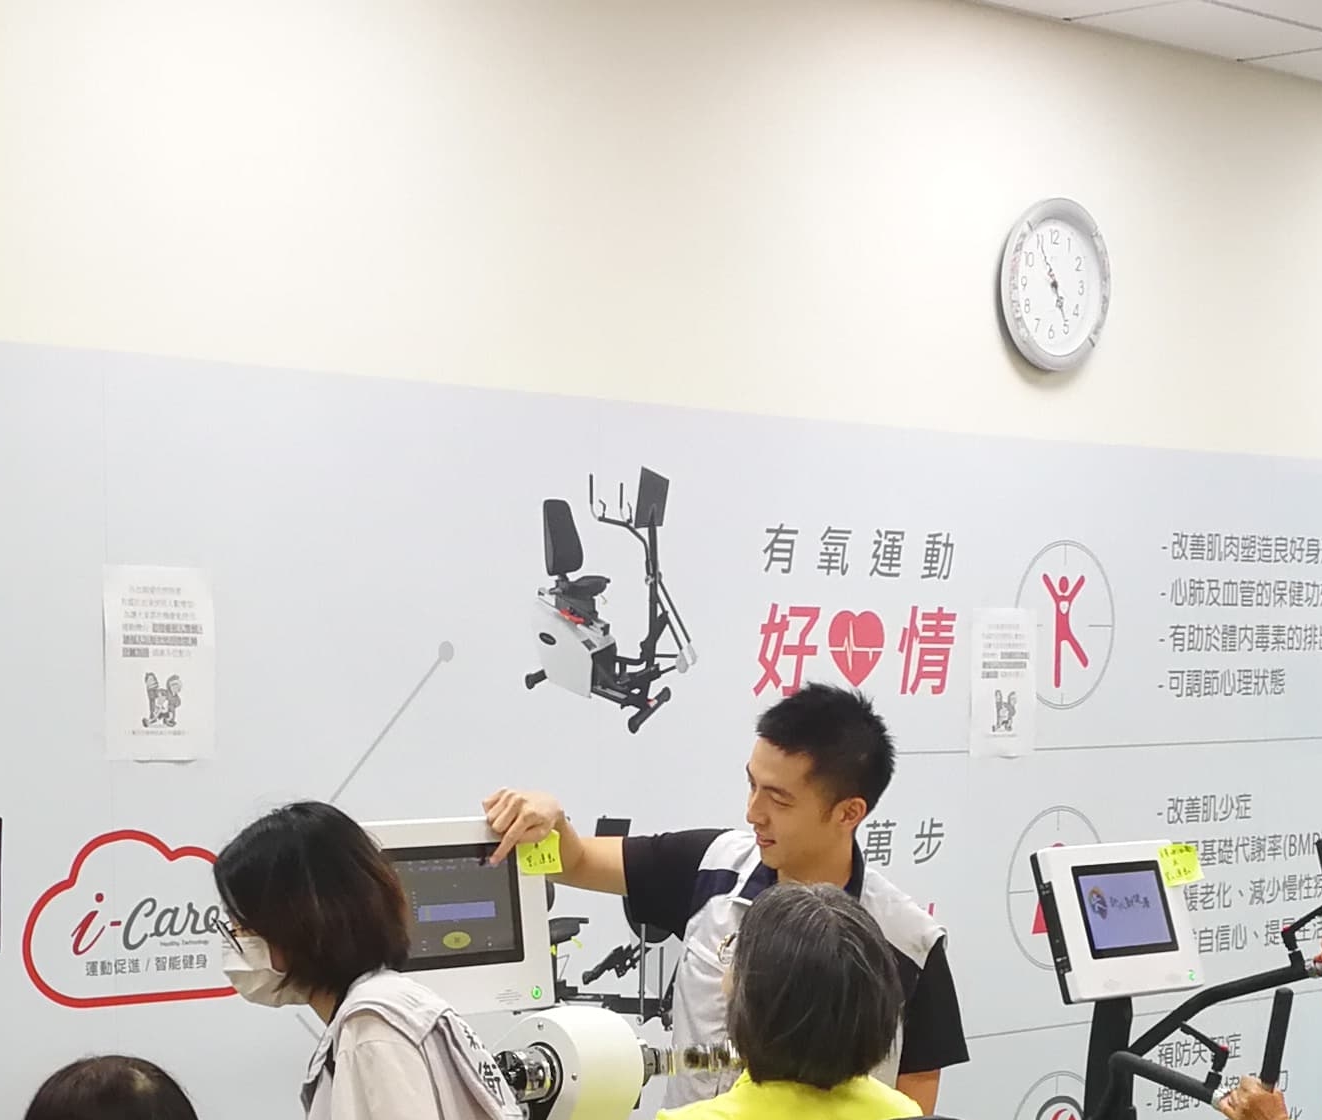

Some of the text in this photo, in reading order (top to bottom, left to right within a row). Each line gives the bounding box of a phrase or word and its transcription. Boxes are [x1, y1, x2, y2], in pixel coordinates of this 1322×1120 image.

[1036, 233, 1044, 249] 11
[1049, 229, 1059, 245] 12
[1025, 251, 1035, 267] 10
[1075, 257, 1082, 272] 2
[1021, 276, 1027, 290] 9
[1078, 281, 1084, 296] 3
[1023, 298, 1030, 313] 8
[1072, 304, 1080, 317] 4
[1034, 318, 1041, 333] 7
[1048, 324, 1054, 339] 6
[1063, 320, 1069, 335] 5
[762, 523, 956, 581] 有氧運動
[1167, 668, 1286, 698] 可調節心理狀態
[1167, 793, 1252, 825] 改善肌少症
[71, 892, 221, 956] i-Care
[86, 958, 141, 977] 運動促進
[155, 954, 208, 971] 智能健身
